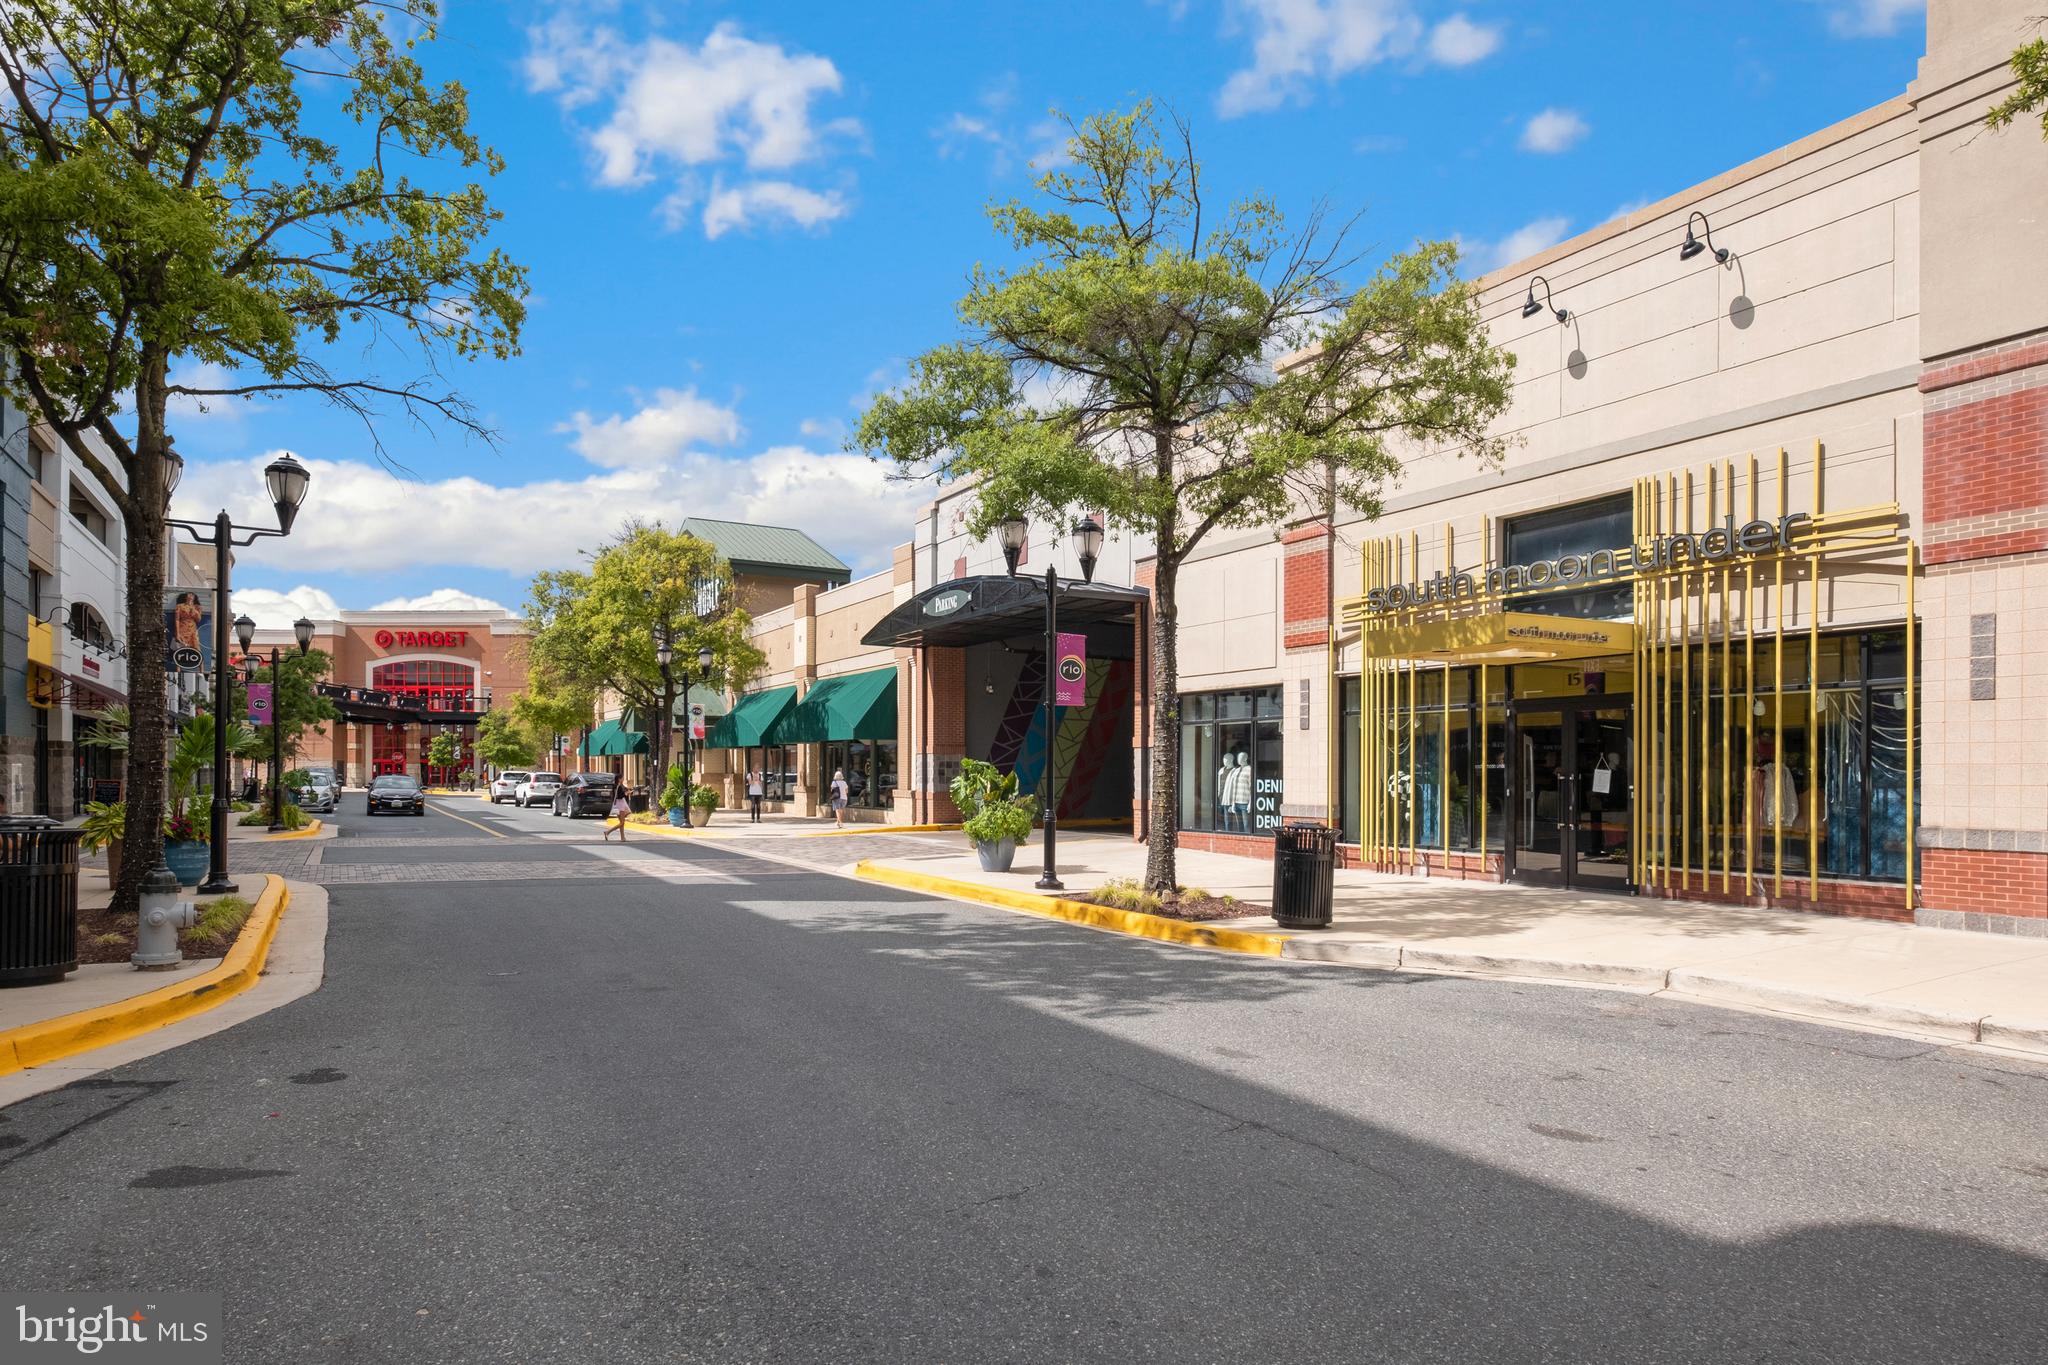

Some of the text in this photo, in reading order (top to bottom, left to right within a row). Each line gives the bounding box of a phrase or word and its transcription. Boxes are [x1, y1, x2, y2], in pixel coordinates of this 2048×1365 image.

[1367, 513, 1807, 612] south moon under
[394, 631, 469, 648] TARGET
[177, 653, 199, 662] rio
[1062, 665, 1080, 675] rio
[1567, 673, 1581, 686] 15
[1256, 797, 1274, 811] ON
